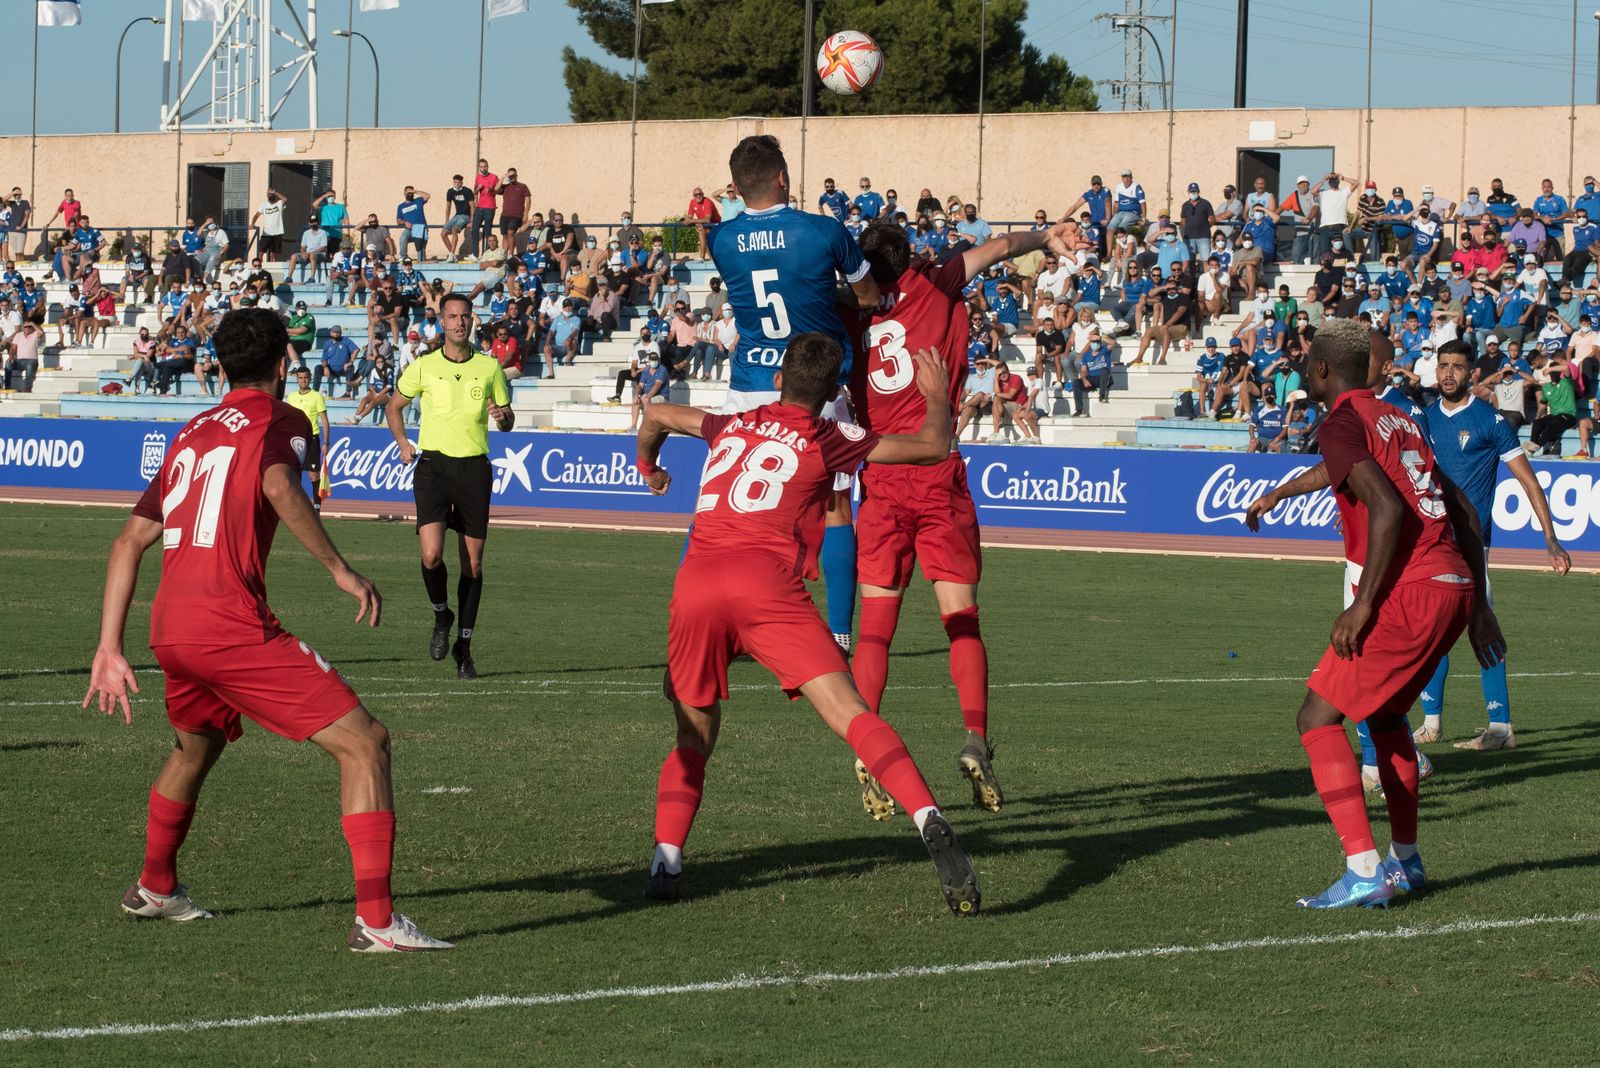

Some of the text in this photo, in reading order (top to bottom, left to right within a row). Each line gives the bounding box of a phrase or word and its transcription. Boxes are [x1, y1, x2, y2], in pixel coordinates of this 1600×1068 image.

[737, 230, 786, 252] S.AYALA
[751, 269, 792, 339] 5
[862, 320, 914, 395] 3
[162, 446, 236, 549] 21
[541, 448, 667, 487] CaixaBa
[696, 437, 799, 514] 28
[981, 462, 1128, 504] CaixaBank
[1400, 450, 1447, 519] 5
